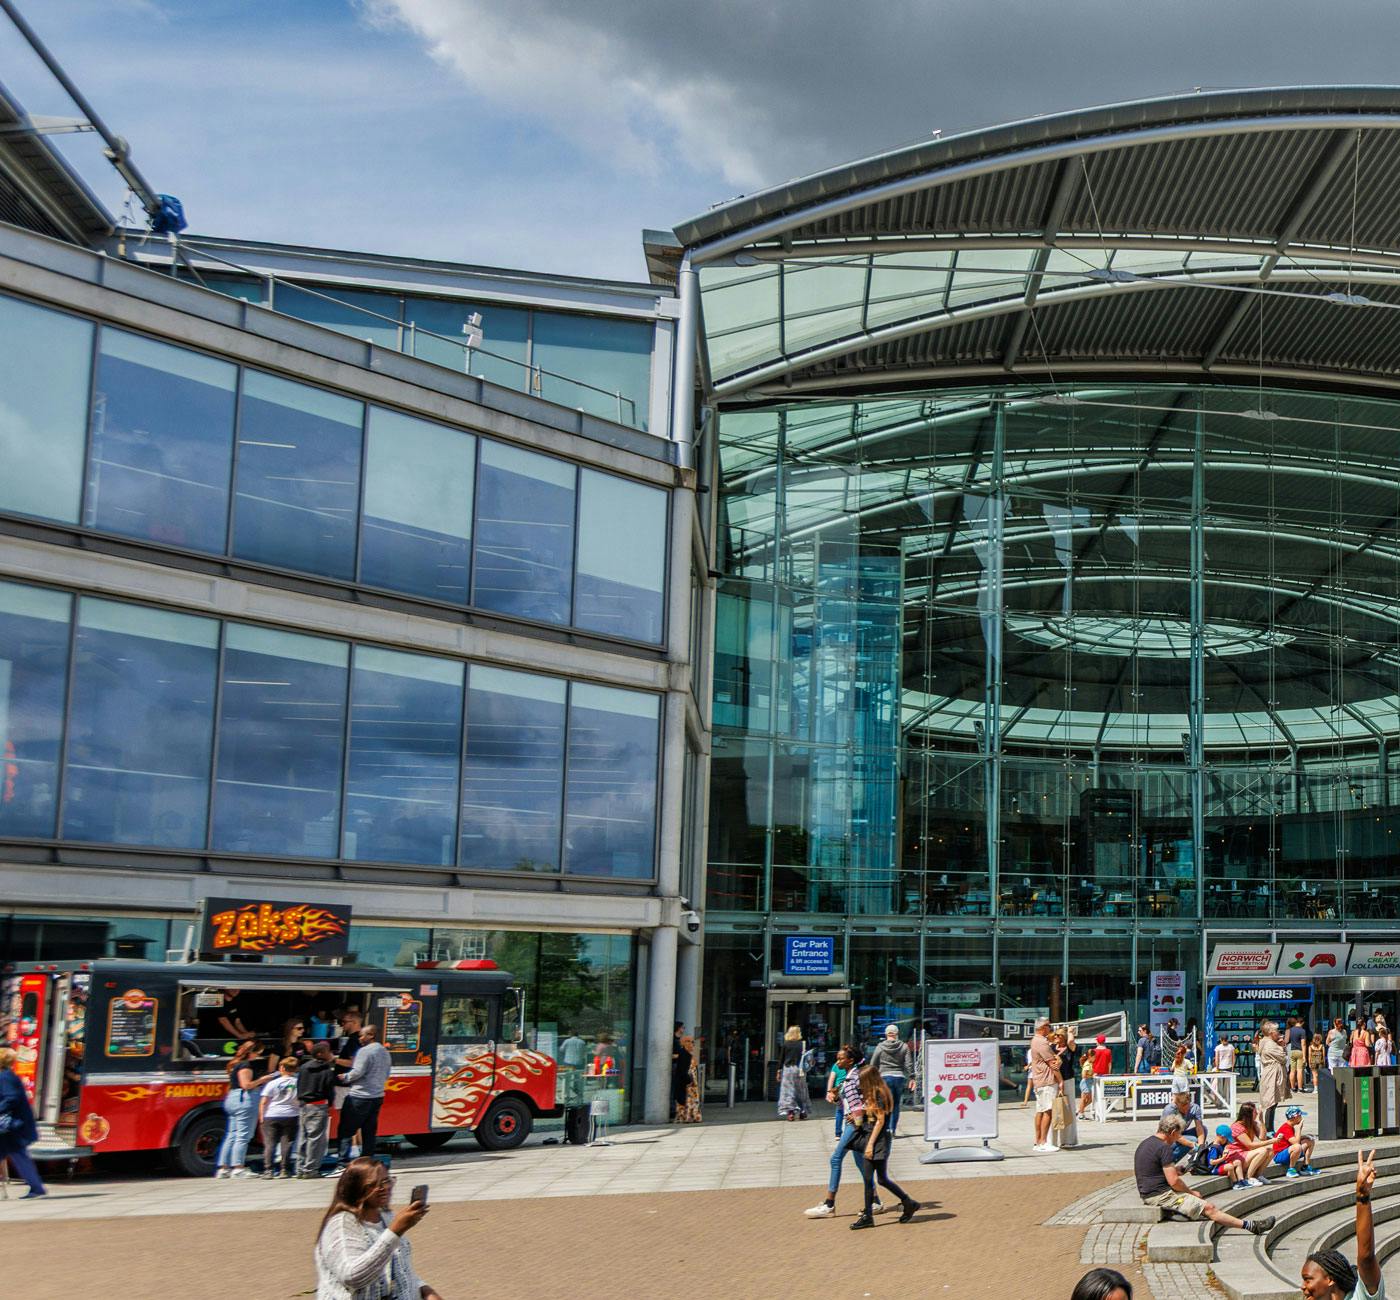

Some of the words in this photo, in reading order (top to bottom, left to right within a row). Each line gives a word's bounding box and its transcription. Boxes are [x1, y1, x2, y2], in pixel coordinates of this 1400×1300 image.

[792, 940, 807, 948] Car
[809, 940, 829, 948] Park
[792, 949, 829, 957] Entrance
[1236, 989, 1294, 1000] INVADERS
[939, 1072, 987, 1081] WELCOME!
[165, 1084, 224, 1098] FAMOUS
